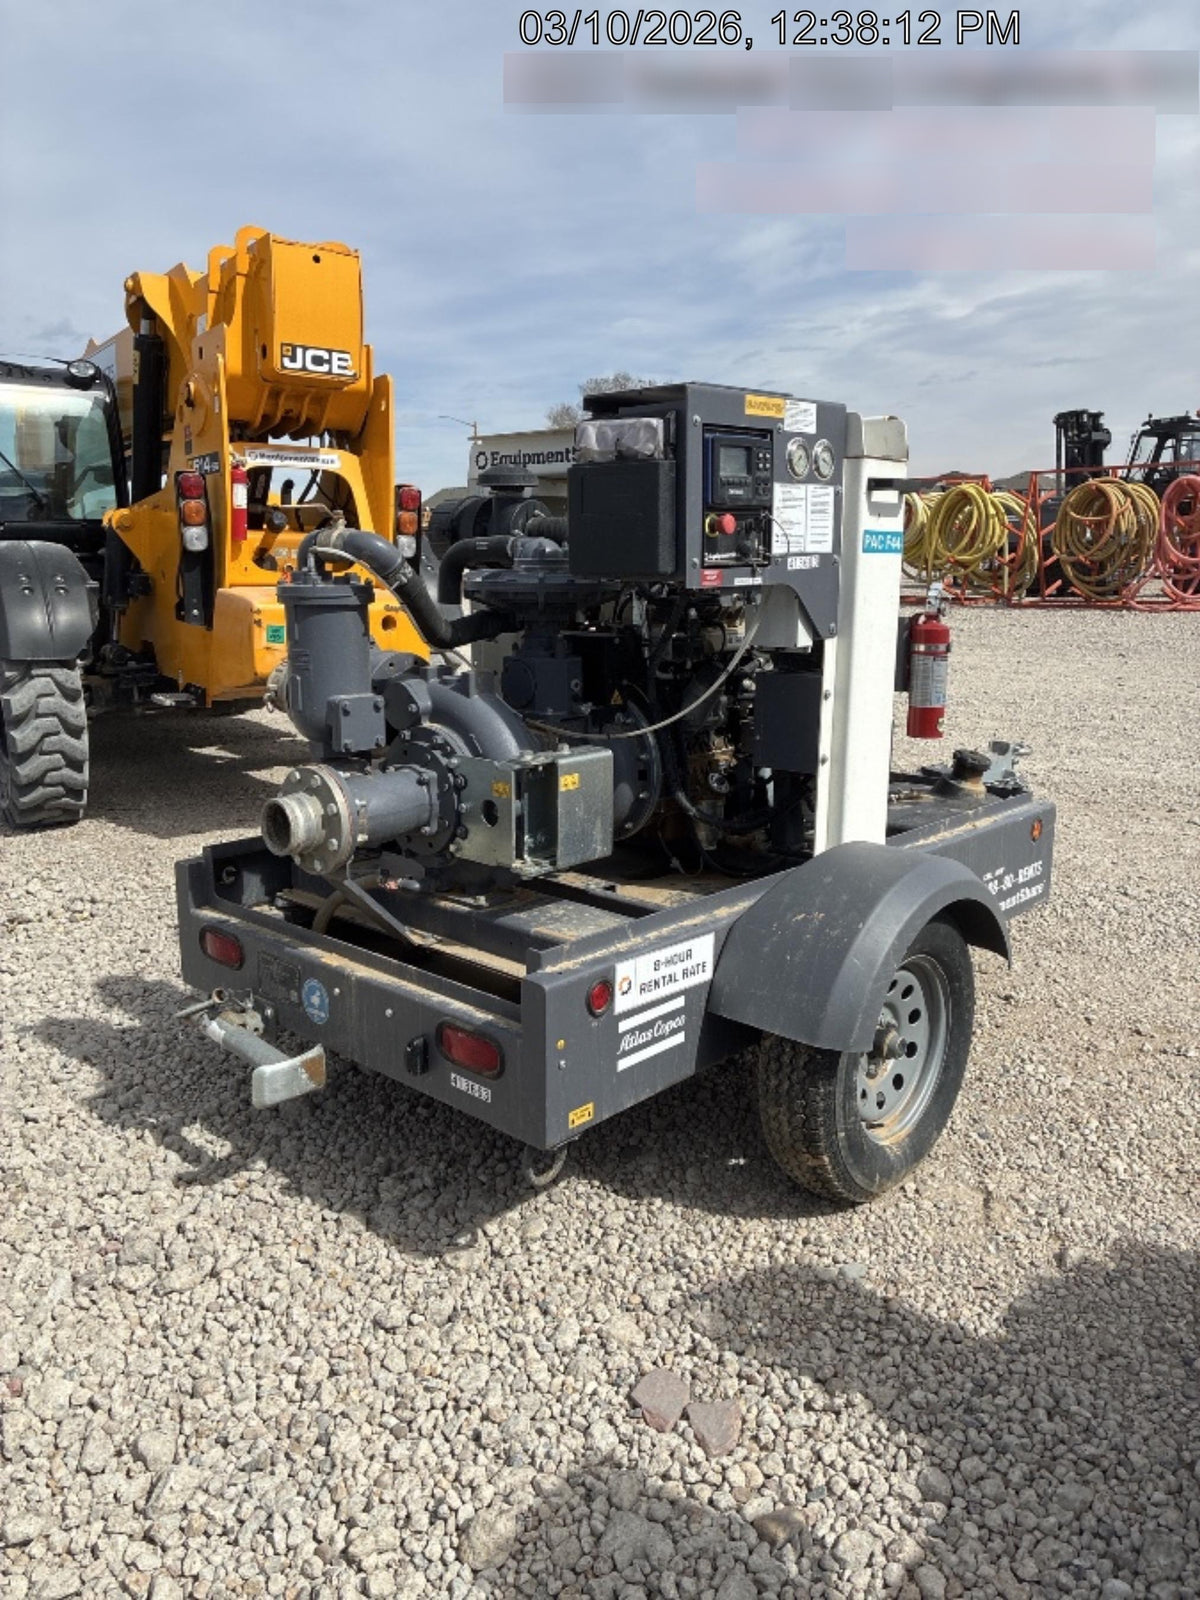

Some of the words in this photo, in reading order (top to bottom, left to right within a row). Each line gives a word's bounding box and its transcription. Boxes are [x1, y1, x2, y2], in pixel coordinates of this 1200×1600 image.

[282, 346, 356, 376] JCB
[864, 533, 884, 550] PAC
[653, 948, 693, 972] 8-HOUR
[640, 973, 680, 996] RENTAL
[682, 961, 708, 980] RATE
[617, 1030, 653, 1055] Atlas
[653, 1014, 686, 1037] Copco
